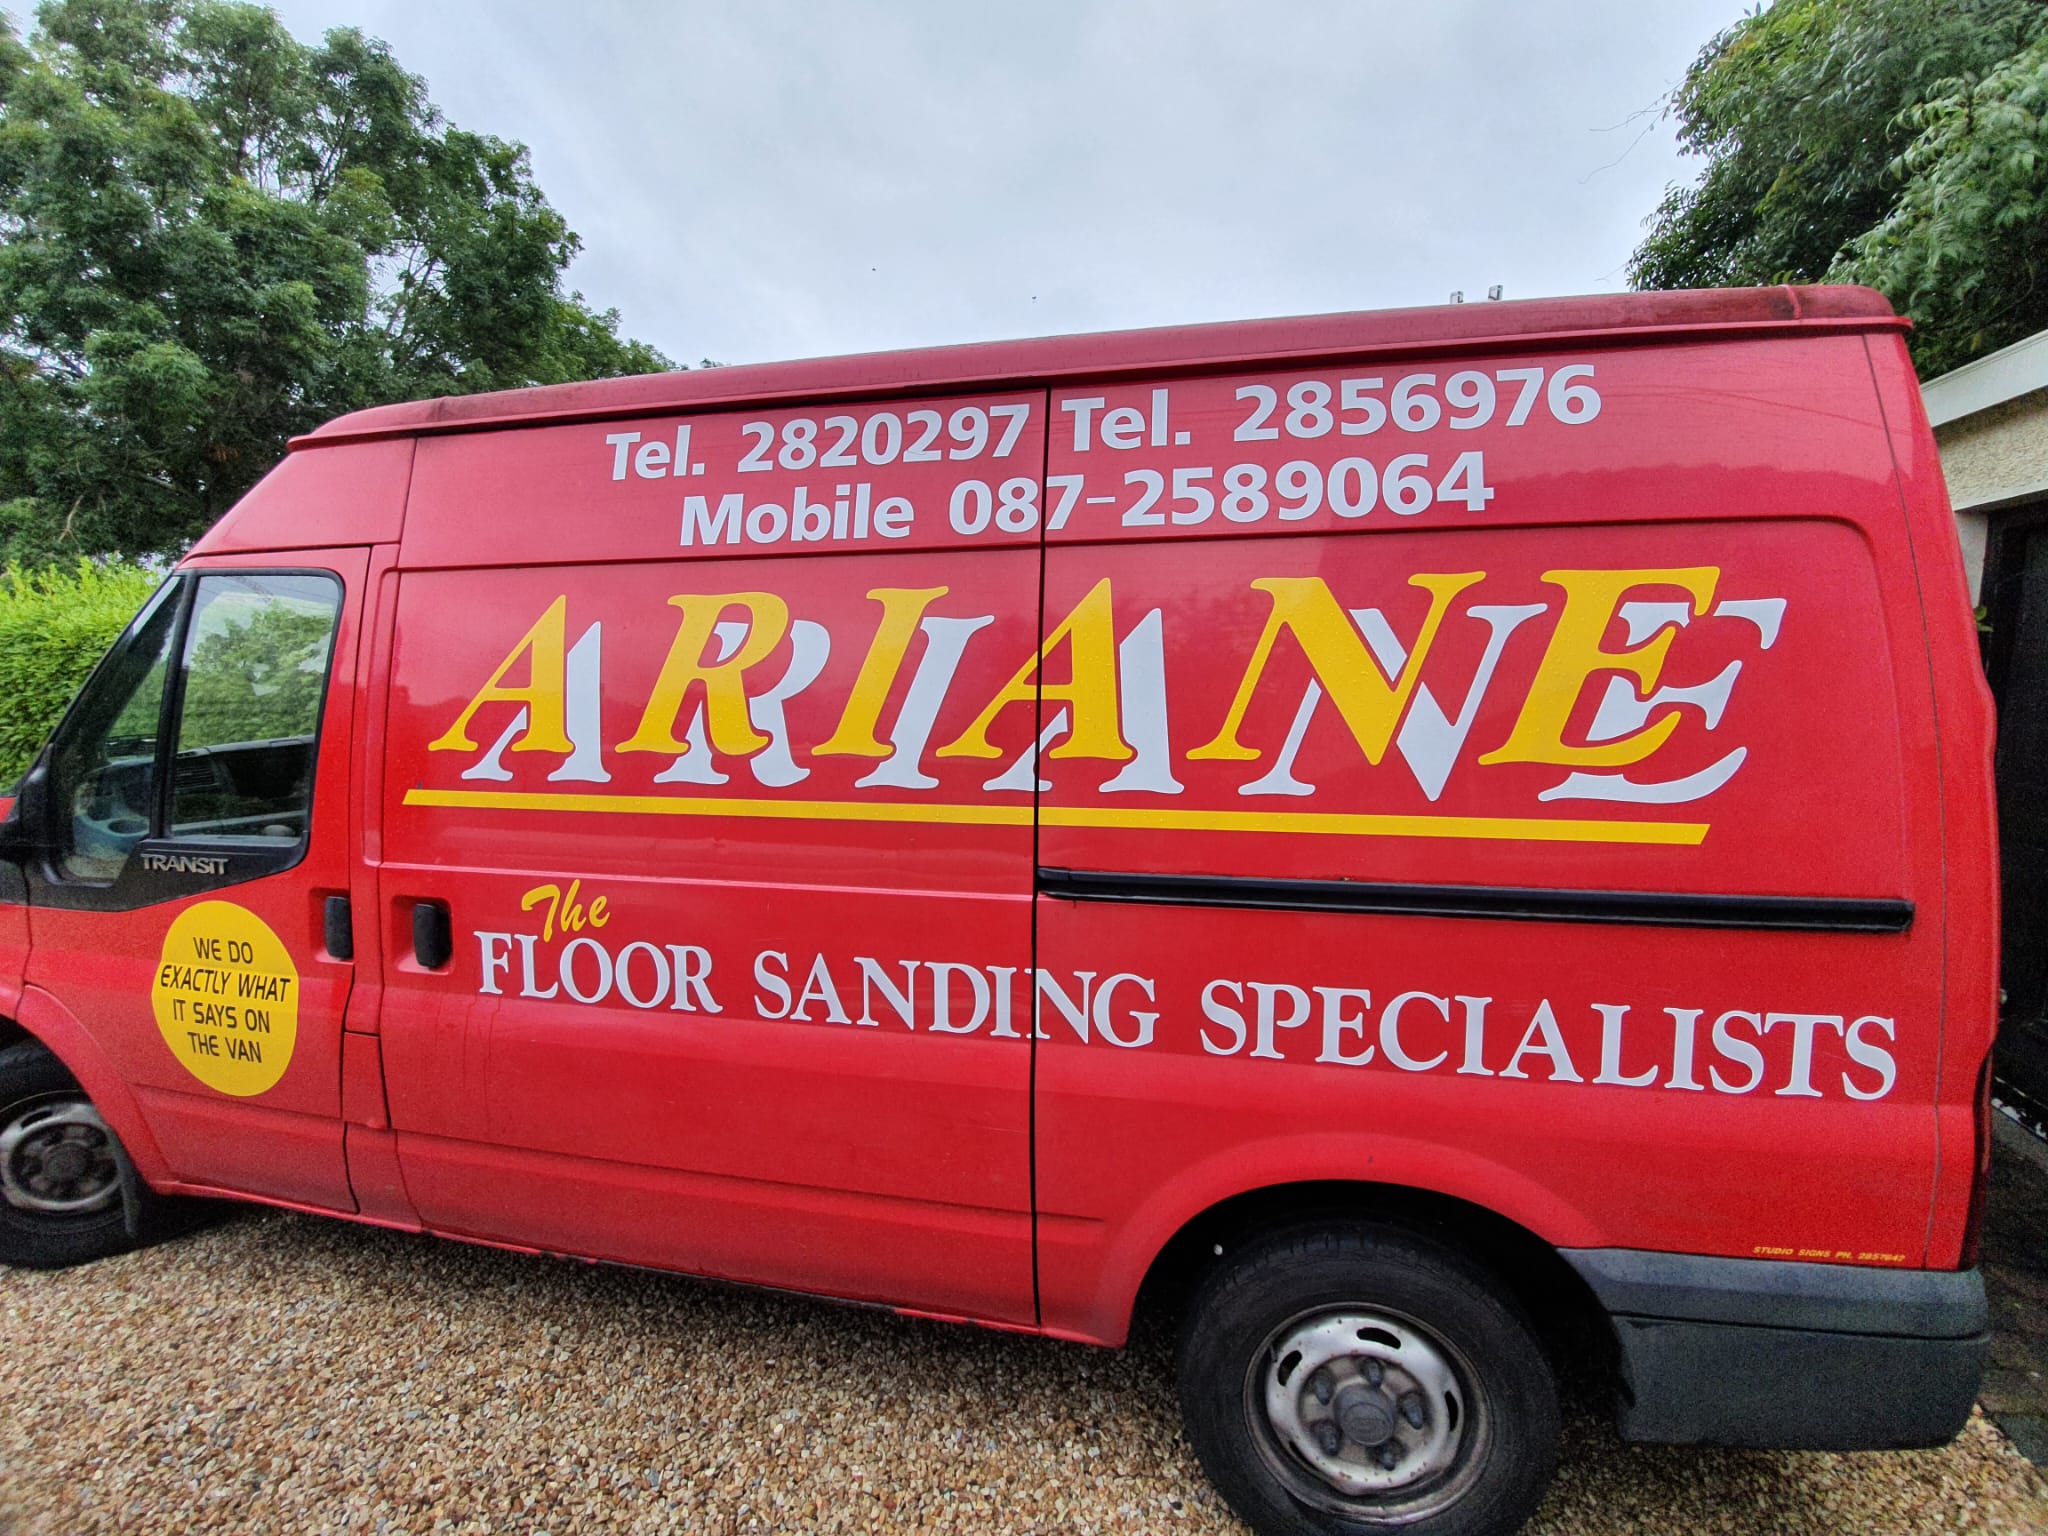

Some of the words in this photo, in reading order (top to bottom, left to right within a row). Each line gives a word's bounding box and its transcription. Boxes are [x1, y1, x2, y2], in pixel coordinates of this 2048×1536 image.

[606, 425, 706, 481] Tel.
[737, 403, 1030, 473] 2820297
[1061, 388, 1191, 452] Tel.
[1233, 364, 1602, 442] 2856976
[679, 483, 915, 547] Mobile
[948, 451, 1495, 536] 087-2589064
[427, 567, 1735, 775] ARIANE
[140, 853, 230, 876] TRANSIT
[522, 879, 610, 942] The
[192, 936, 221, 961] WE
[228, 940, 254, 964] DO
[160, 964, 232, 995] EXACTLY
[238, 973, 291, 1003] WHAT
[172, 998, 186, 1022] IT
[193, 1002, 237, 1028] SAYS
[245, 1008, 271, 1034] ON
[473, 931, 724, 1014] FLOOR
[754, 951, 1160, 1048] SANDING
[1200, 979, 1897, 1101] SPECIALISTS
[187, 1031, 220, 1057] THE
[225, 1037, 263, 1064] VAN
[1753, 1246, 1794, 1256] STUDIO
[1798, 1248, 1831, 1258] SIGNS
